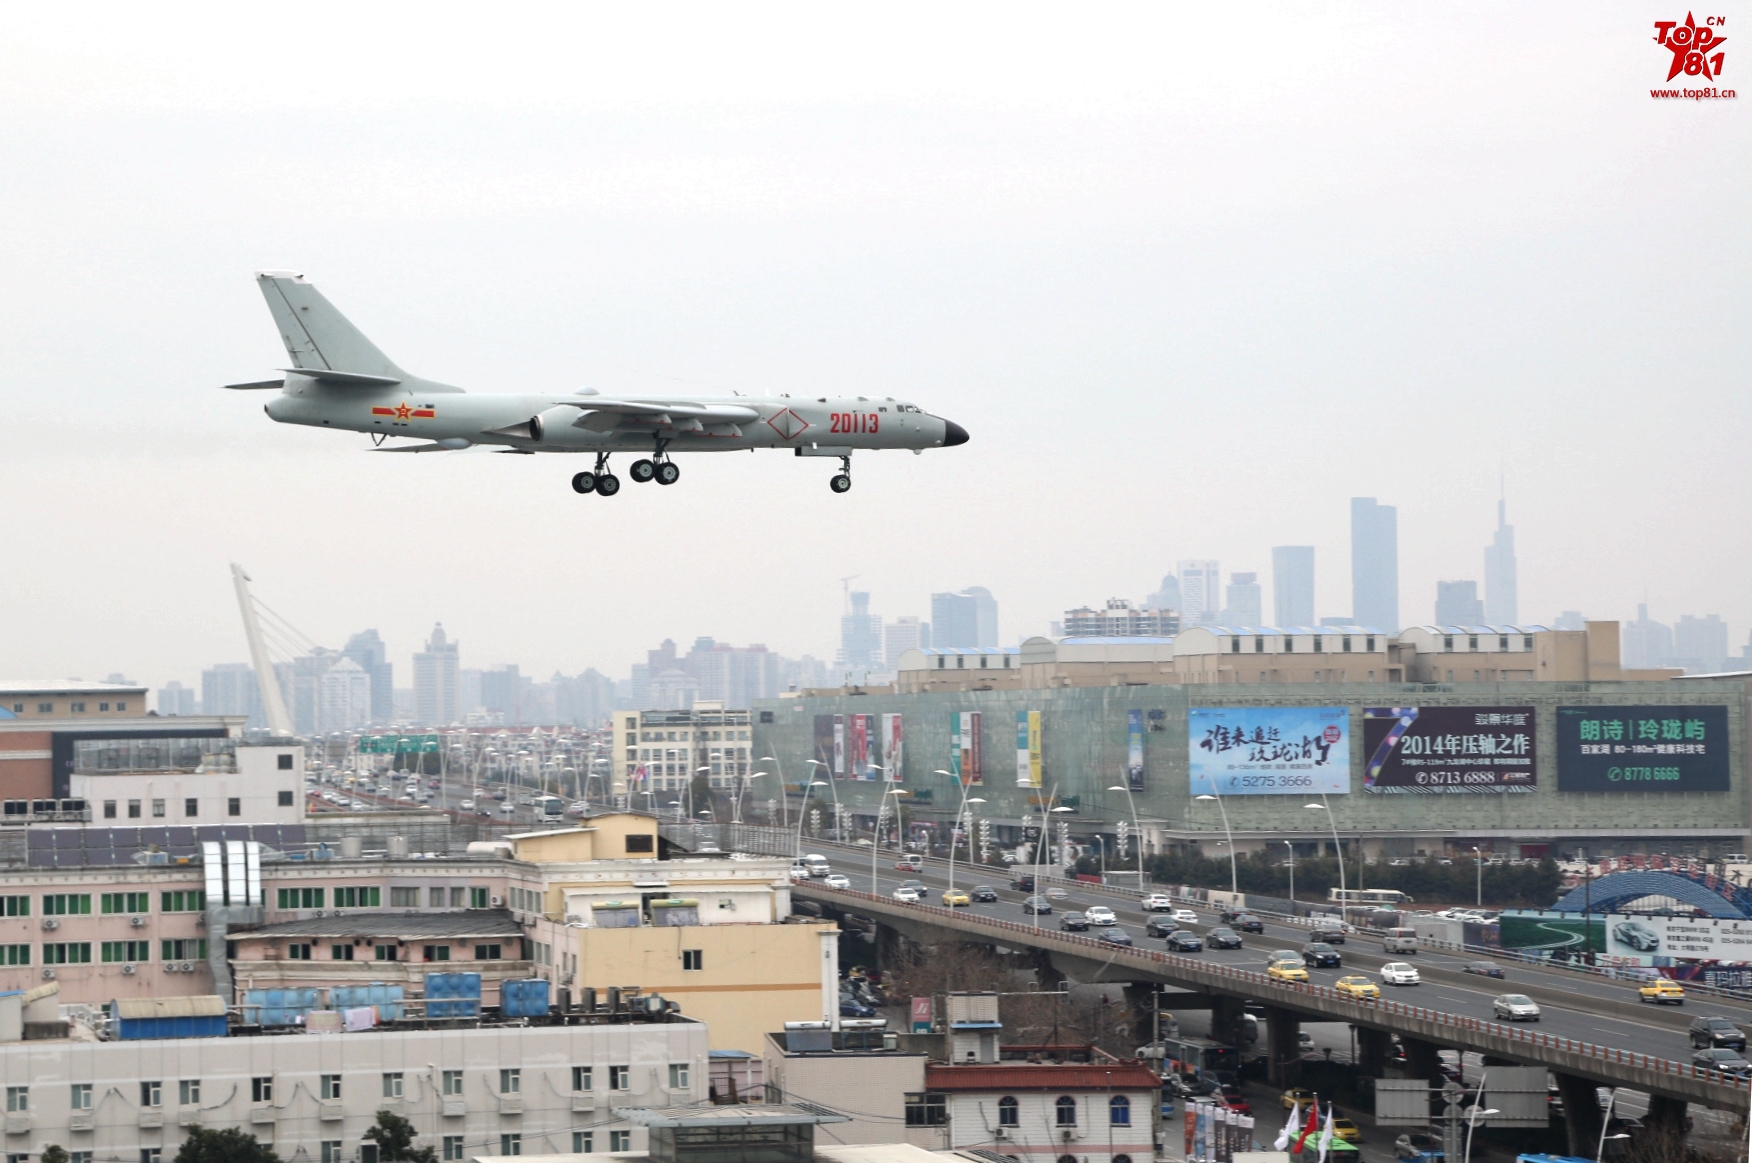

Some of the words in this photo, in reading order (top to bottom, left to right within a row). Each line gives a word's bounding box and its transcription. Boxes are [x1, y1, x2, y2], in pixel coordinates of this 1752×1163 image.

[830, 413, 879, 434] 20113
[1579, 719, 1624, 741] 朗诗
[1638, 719, 1706, 741] 玲珑屿
[1200, 724, 1281, 755] 谁来追赶
[1400, 734, 1531, 755] 2014年压轴之作
[1580, 744, 1611, 755] 百家湖
[1242, 776, 1275, 787] 5275
[1278, 776, 1312, 787] 3666
[1430, 771, 1461, 784] 8713
[1464, 771, 1496, 784] 6888
[1624, 767, 1652, 781] 8778
[1654, 767, 1680, 781] 6666
